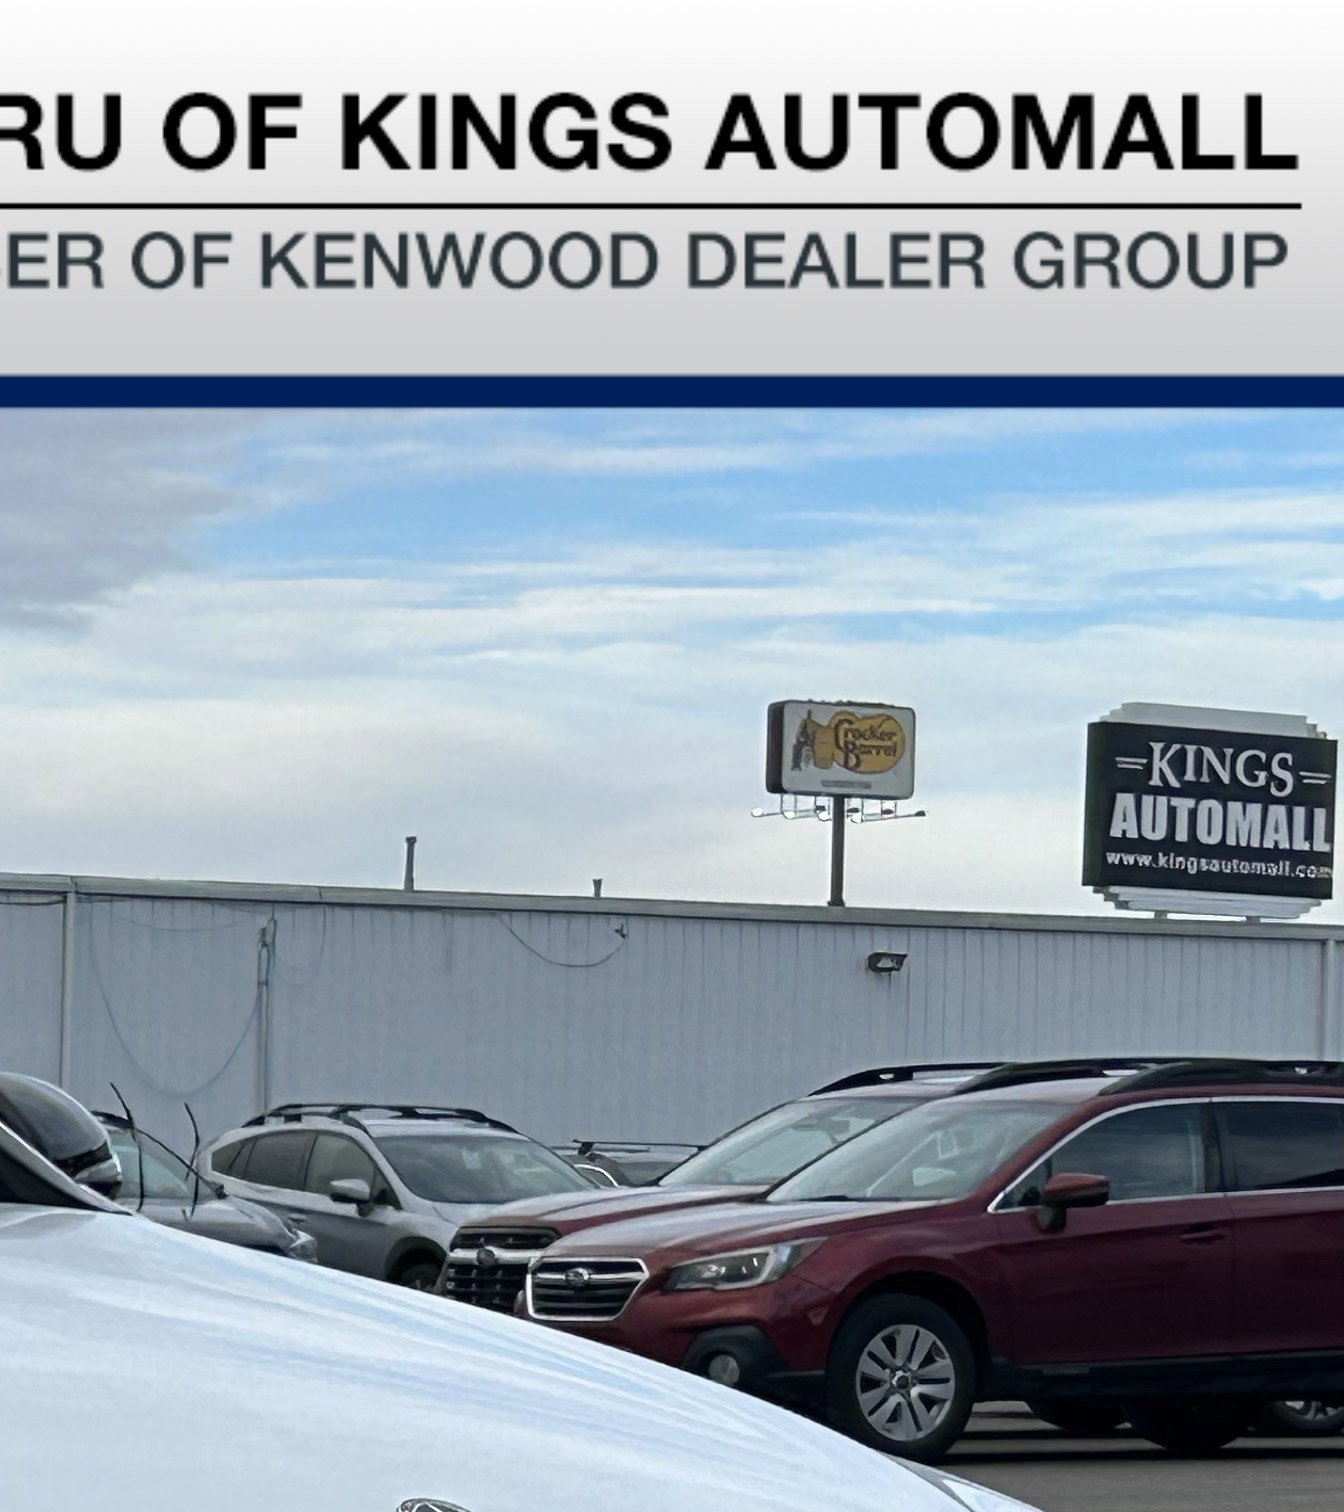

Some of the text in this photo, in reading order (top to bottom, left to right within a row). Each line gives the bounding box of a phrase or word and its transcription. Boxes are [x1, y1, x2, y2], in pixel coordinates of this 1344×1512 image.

[1148, 741, 1294, 798] KINGS
[1109, 792, 1332, 853] AUTOMALL
[1105, 851, 1332, 879] www.kingsautomall.com
